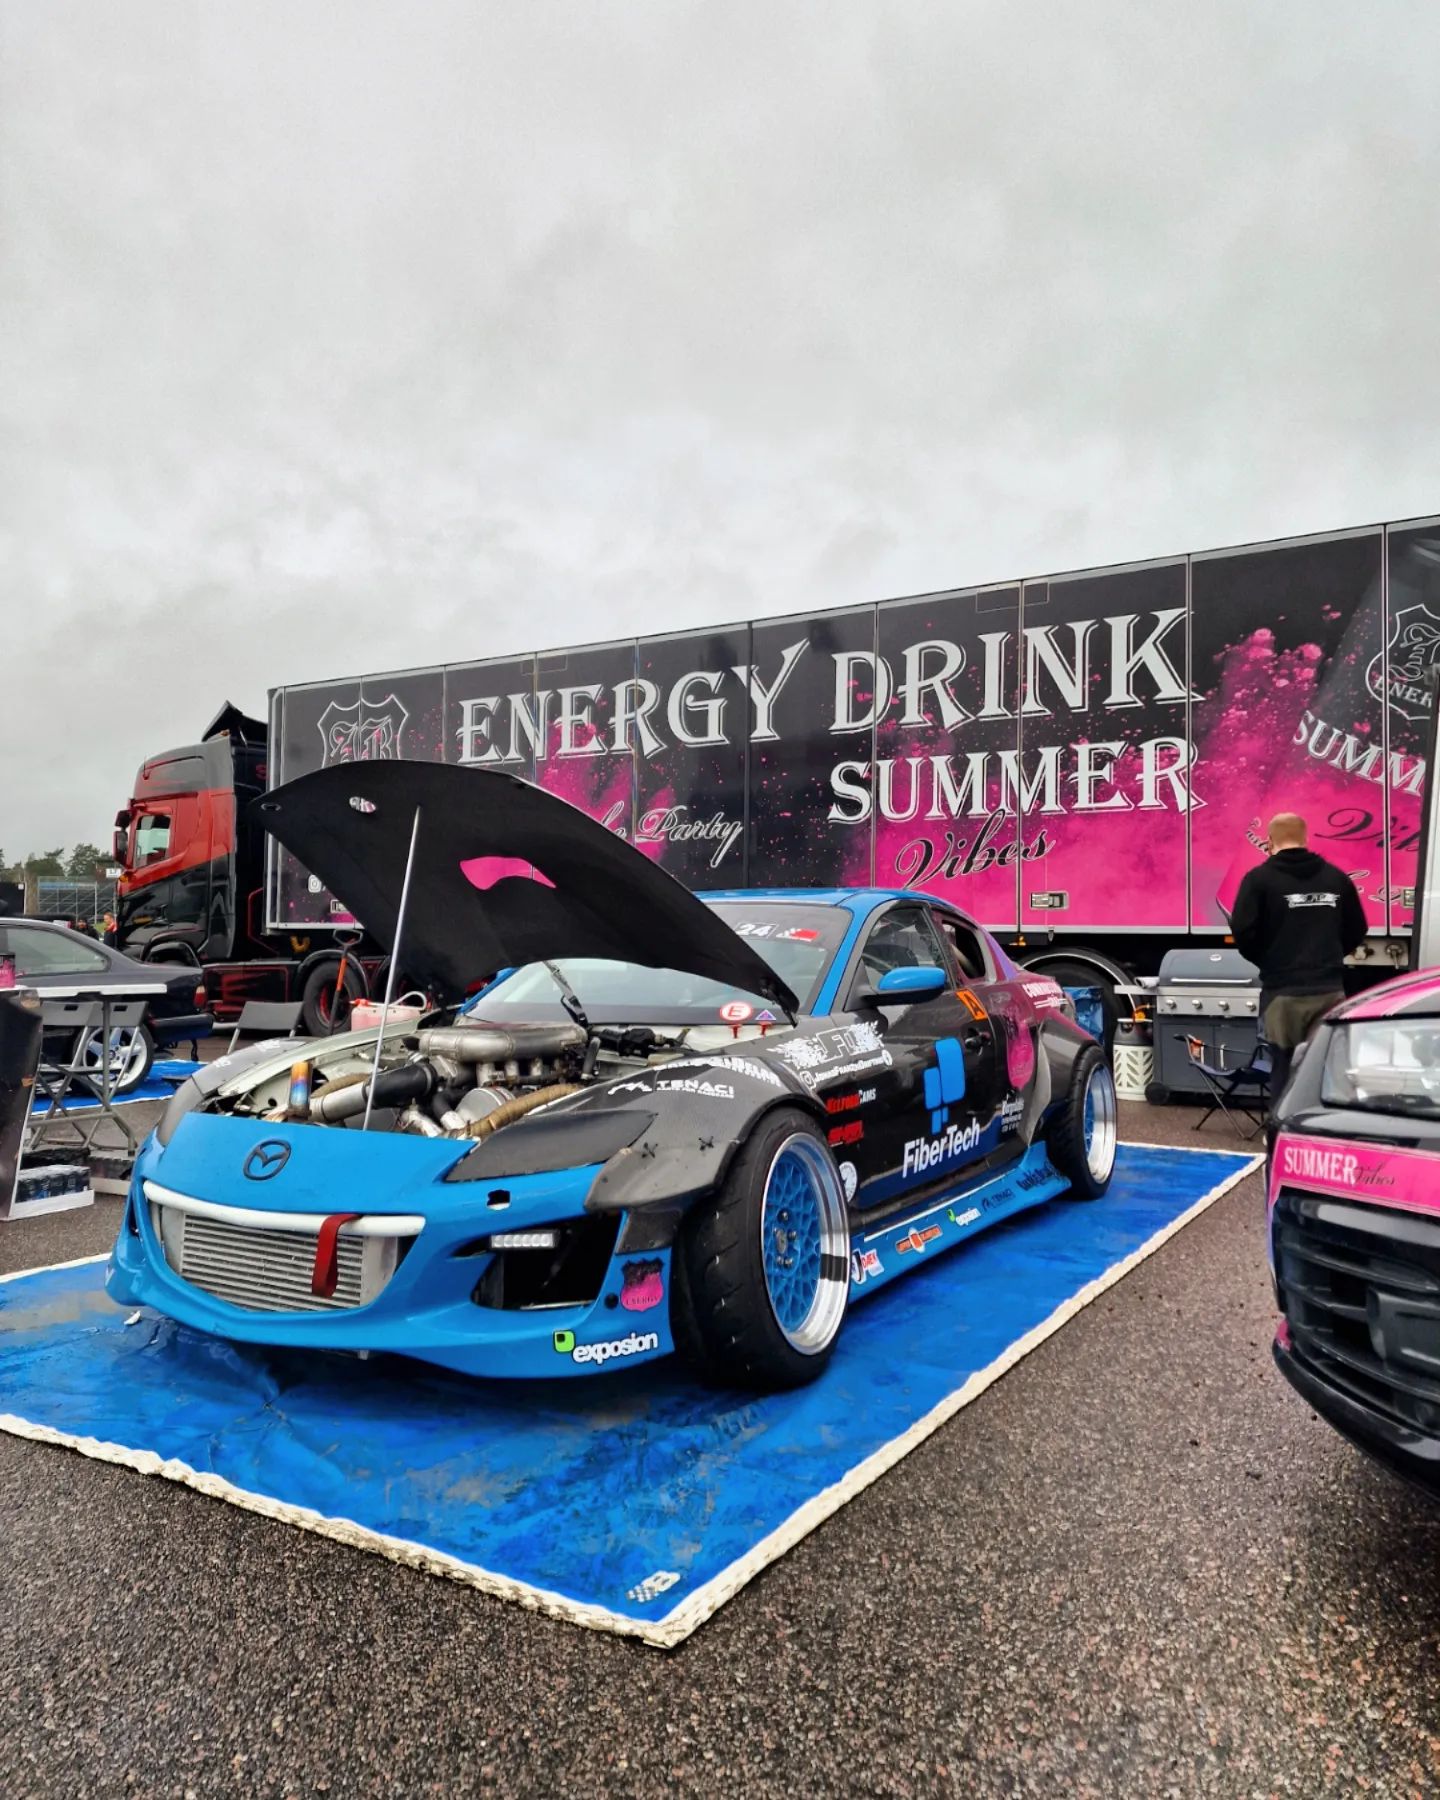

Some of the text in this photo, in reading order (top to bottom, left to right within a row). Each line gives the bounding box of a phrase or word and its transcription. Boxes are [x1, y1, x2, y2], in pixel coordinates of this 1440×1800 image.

[455, 606, 1206, 767] ENERGY DRINK
[827, 736, 1208, 826] SUMMER
[634, 804, 744, 868] Party
[894, 808, 1058, 890] Vibes
[902, 1117, 981, 1179] FiberTech
[1284, 1146, 1358, 1186] SUMMER
[572, 1332, 658, 1365] exposion
